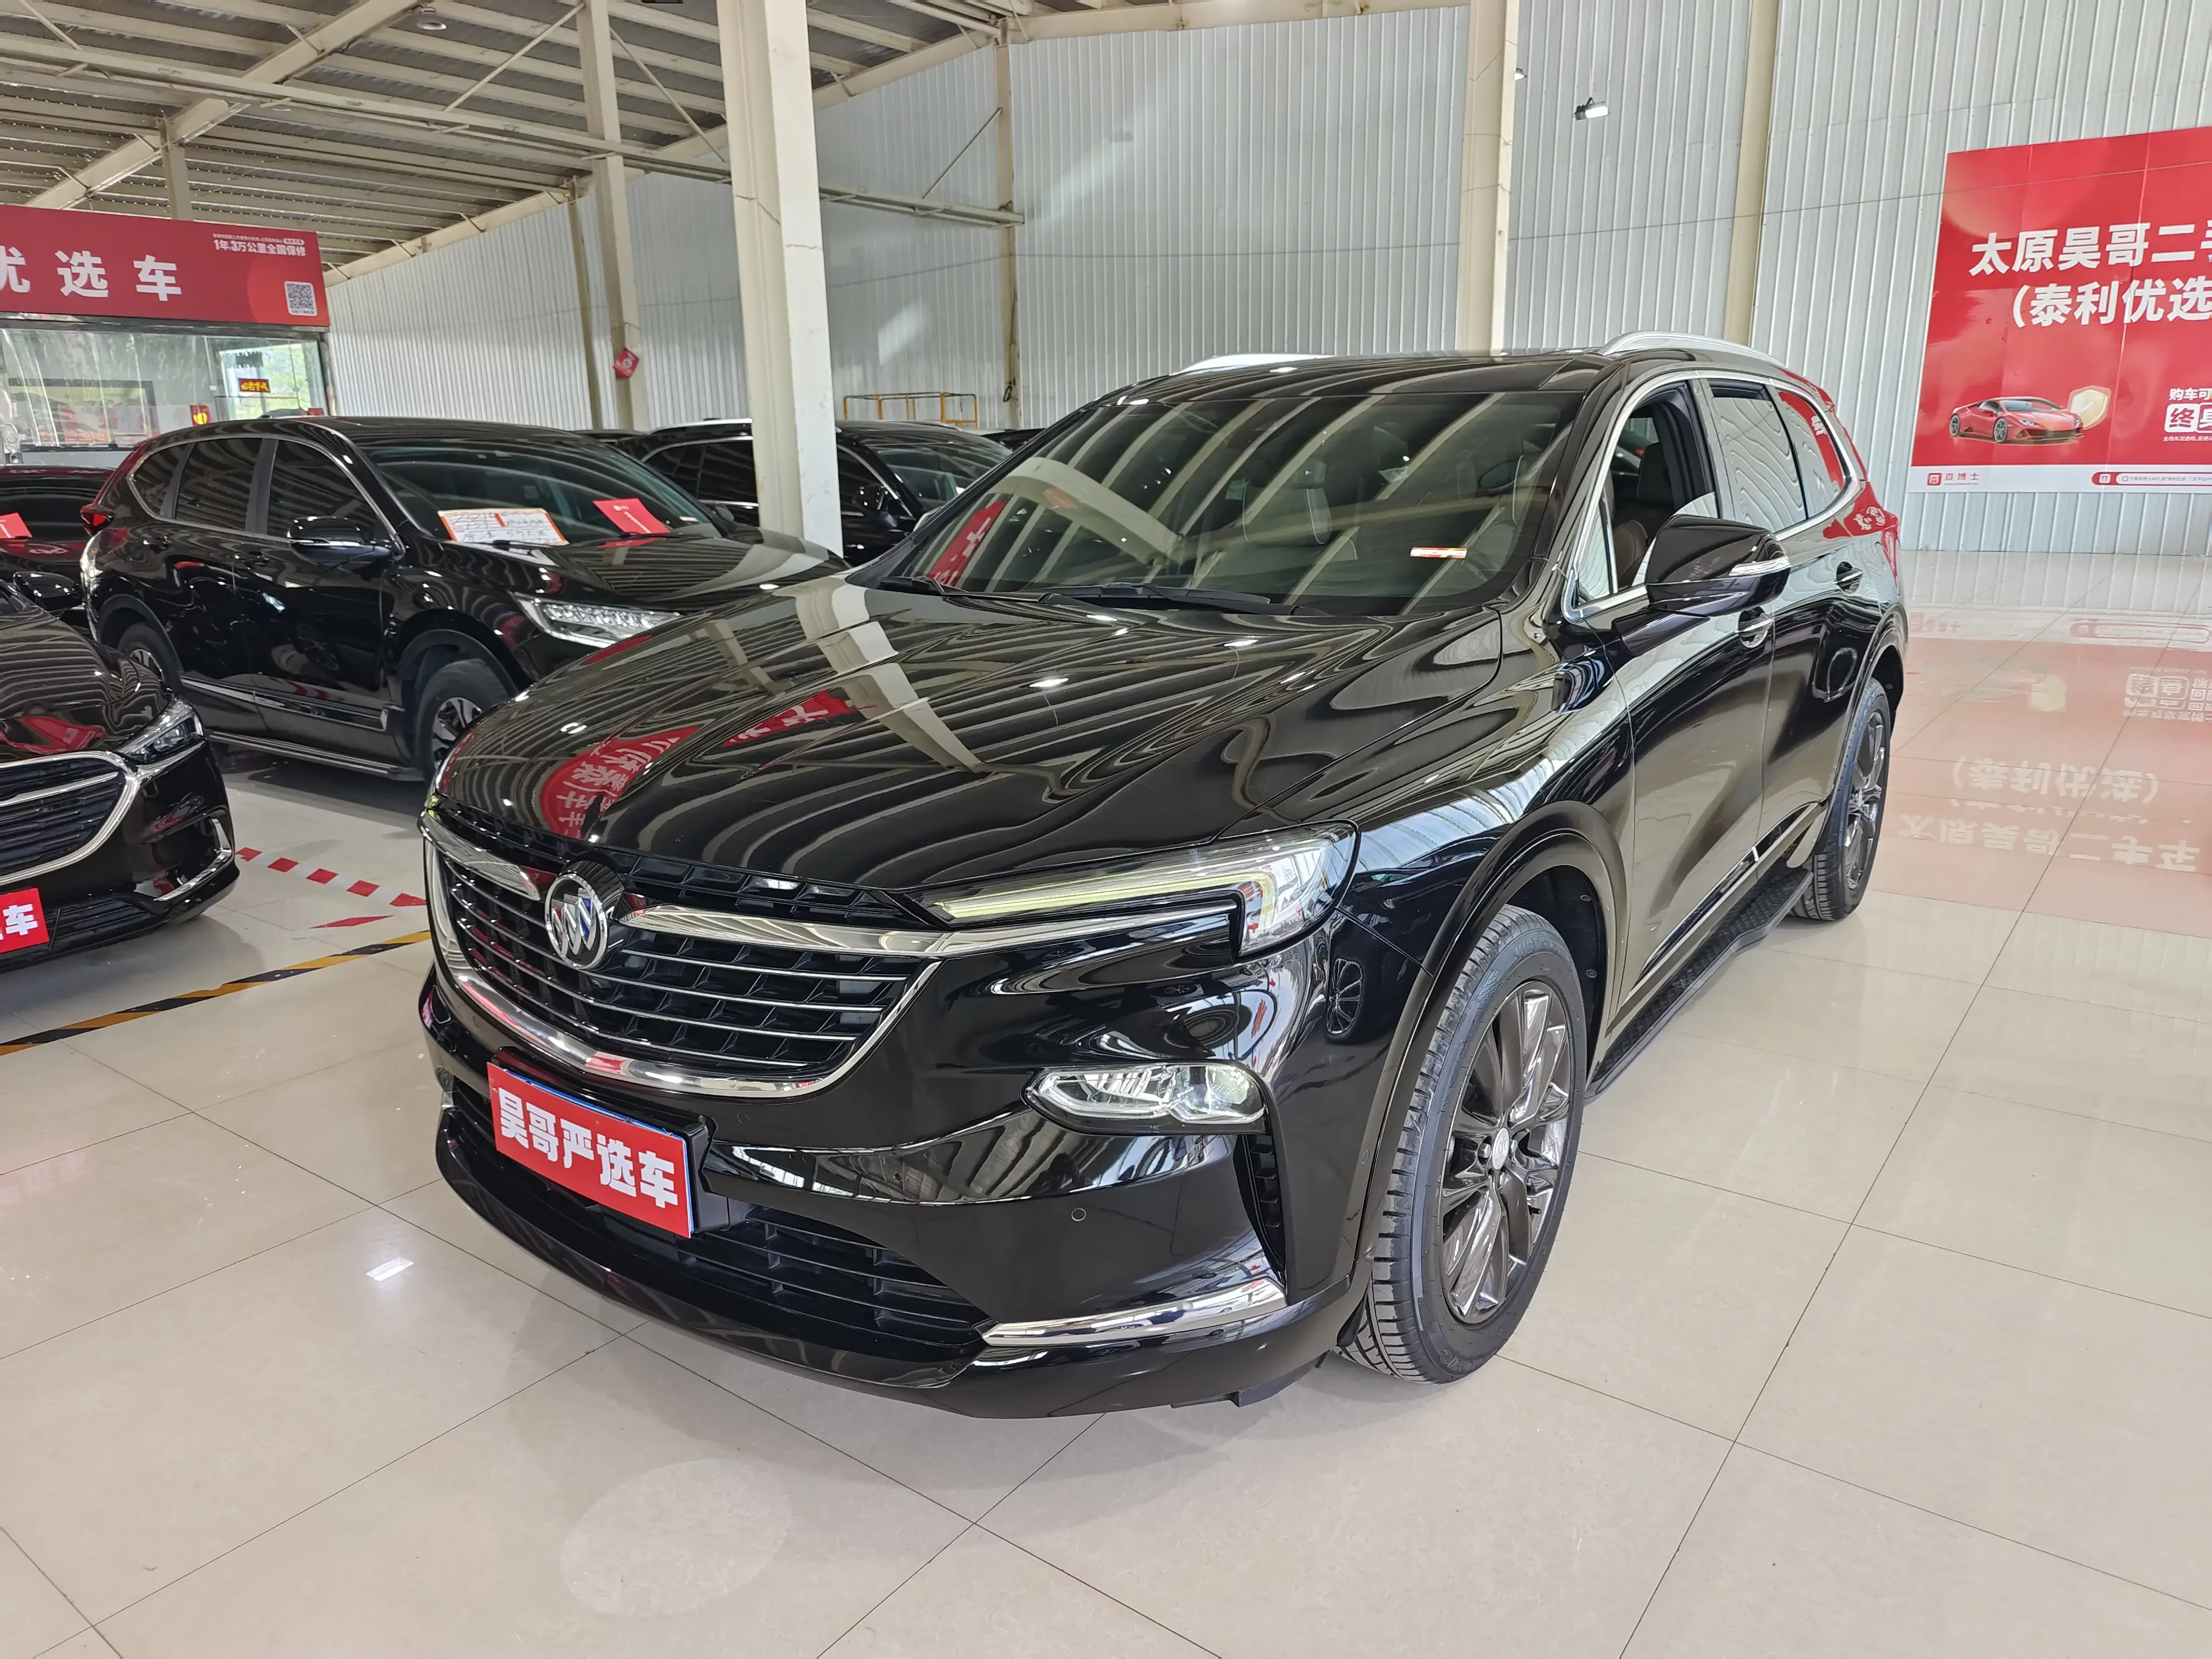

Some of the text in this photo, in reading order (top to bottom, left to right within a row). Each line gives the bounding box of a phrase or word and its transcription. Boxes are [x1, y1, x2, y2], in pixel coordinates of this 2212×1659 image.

[0, 903, 38, 940] 车
[498, 1087, 678, 1209] 昊哥严选车
